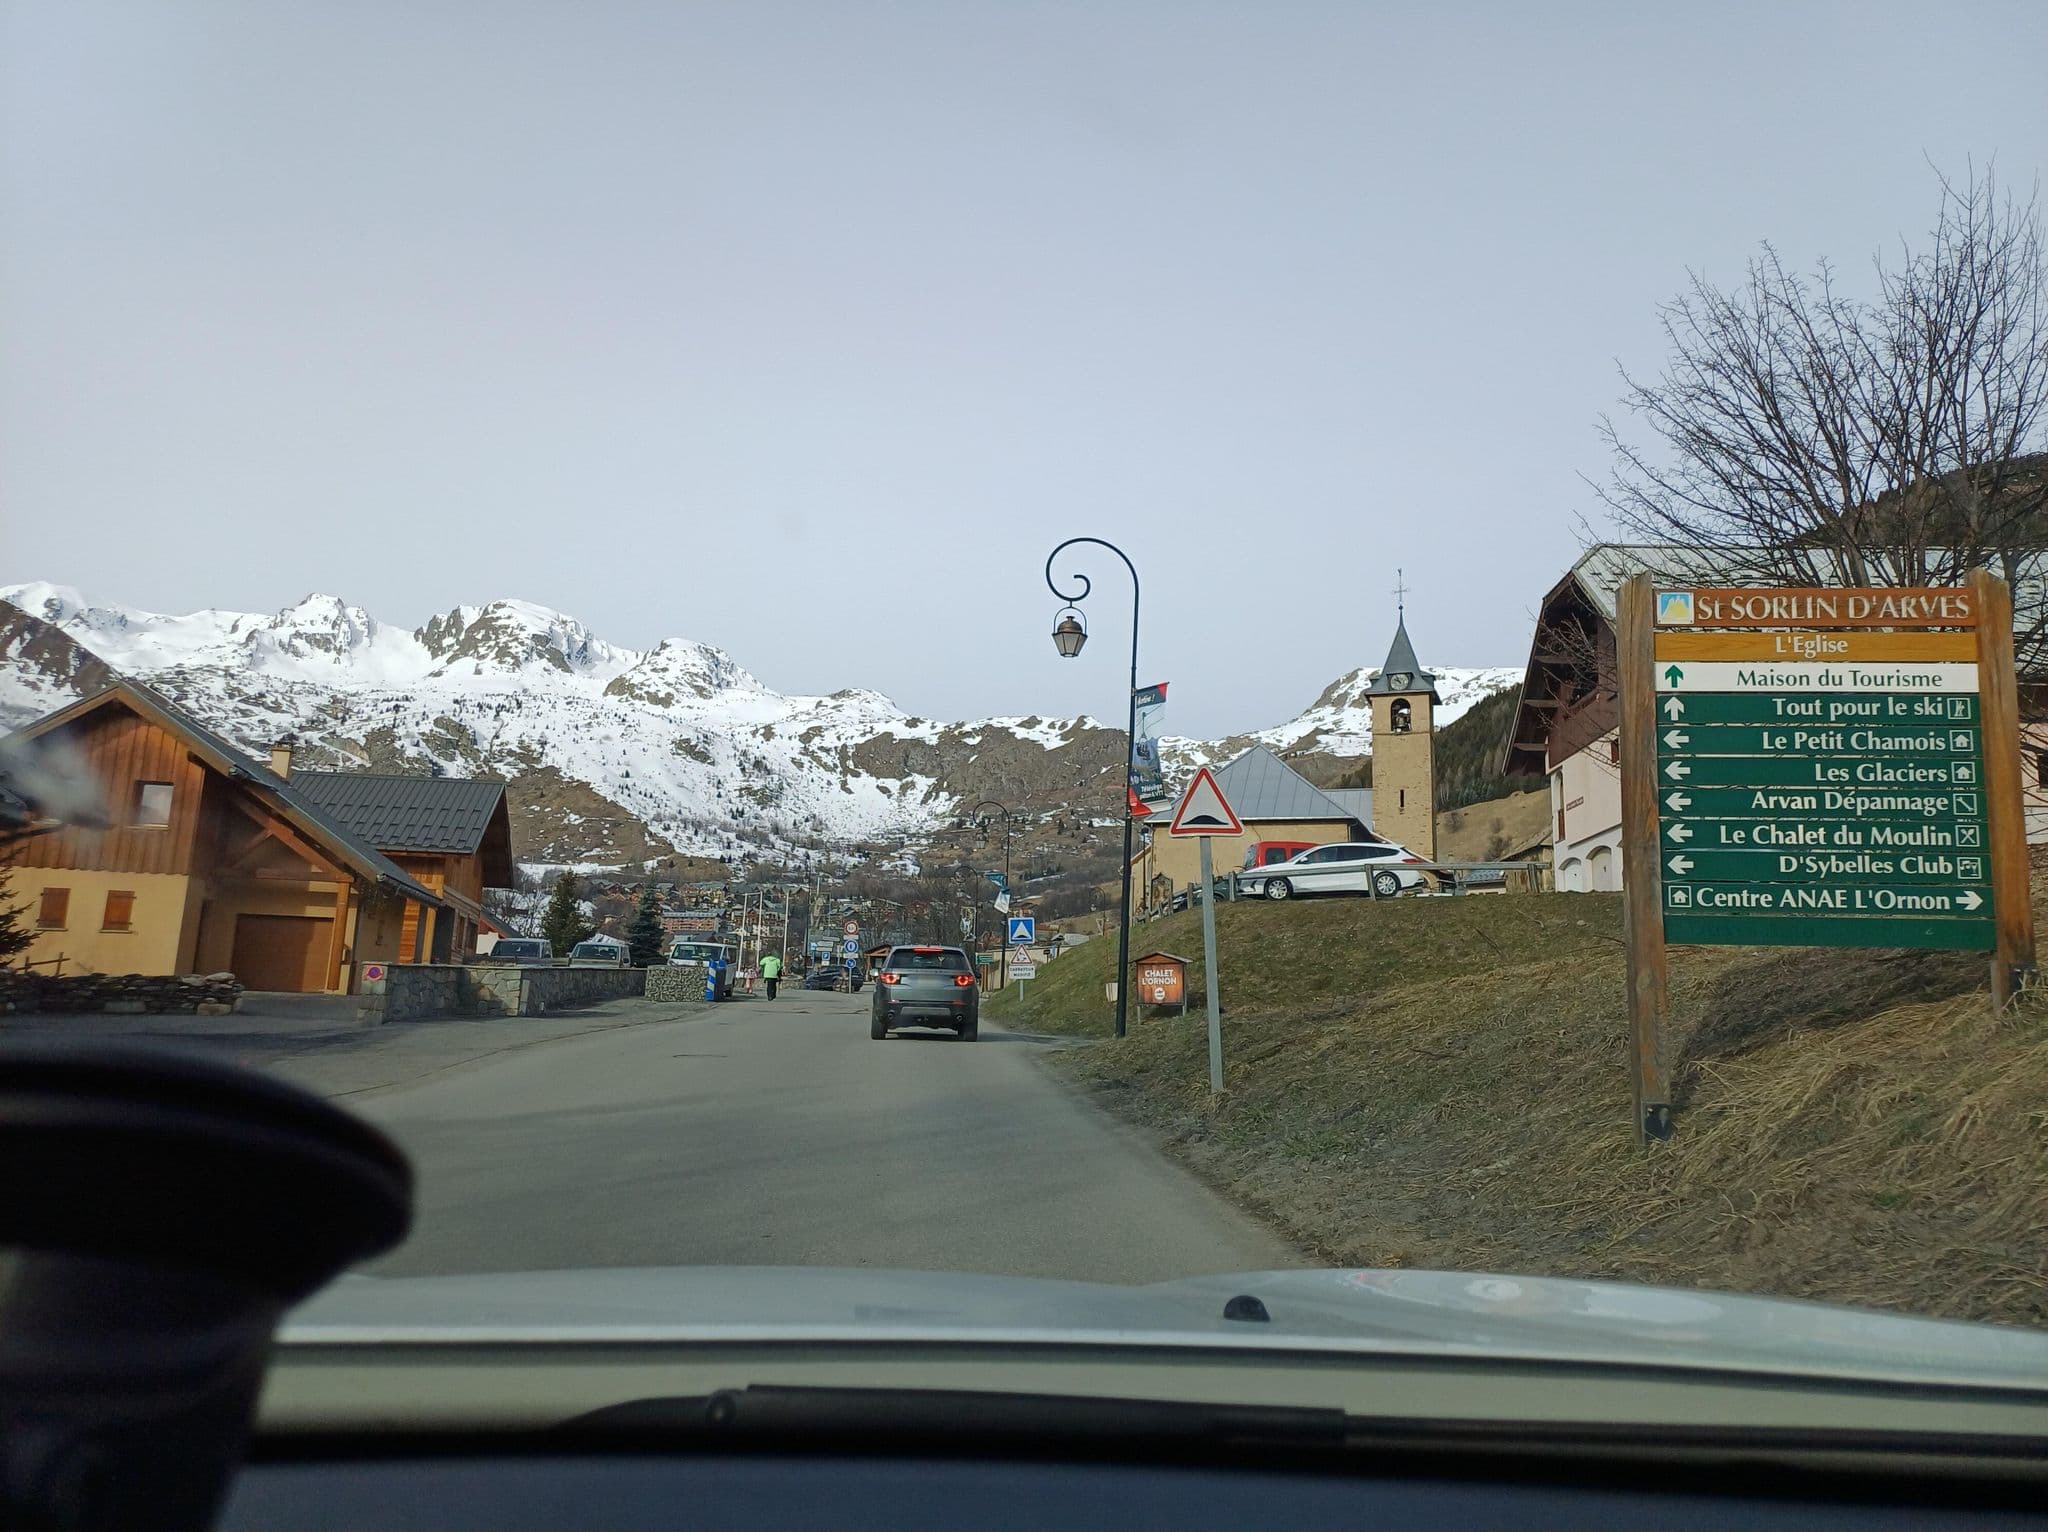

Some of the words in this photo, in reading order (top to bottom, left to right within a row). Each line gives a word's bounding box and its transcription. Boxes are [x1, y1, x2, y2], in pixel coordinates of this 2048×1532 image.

[1698, 597, 1721, 619] St
[1731, 596, 1836, 619] SORLIN
[1848, 596, 1970, 618] D'ARVES
[1775, 635, 1847, 658] L'Eglise
[1737, 669, 1809, 686] Maison
[1818, 669, 1842, 686] du
[1848, 670, 1942, 686] Tourisme
[1772, 698, 1822, 716] Tout
[1829, 703, 1880, 721] pour
[1887, 697, 1907, 715] le
[1913, 697, 1942, 715] ski
[1762, 732, 1787, 749] Le
[1794, 731, 1844, 749] Petit
[1850, 731, 1945, 750] Chamois
[1815, 764, 1849, 781] Les
[1856, 763, 1947, 781] Glaciers
[1751, 792, 1816, 809] Arvan
[1824, 791, 1948, 816] Dépannage
[1720, 826, 1745, 843] Le
[1752, 824, 1826, 844] Chalet
[1833, 825, 1862, 844] du
[1870, 826, 1951, 845] Moulin
[1779, 855, 1893, 878] D'Sybelles
[1899, 856, 1952, 874] Club
[1696, 888, 1772, 907] Centre
[1781, 890, 1847, 908] ANAE
[1855, 890, 1950, 909] L'Ornon
[1141, 977, 1177, 985] L'ORNON
[1144, 969, 1174, 977] CHALET
